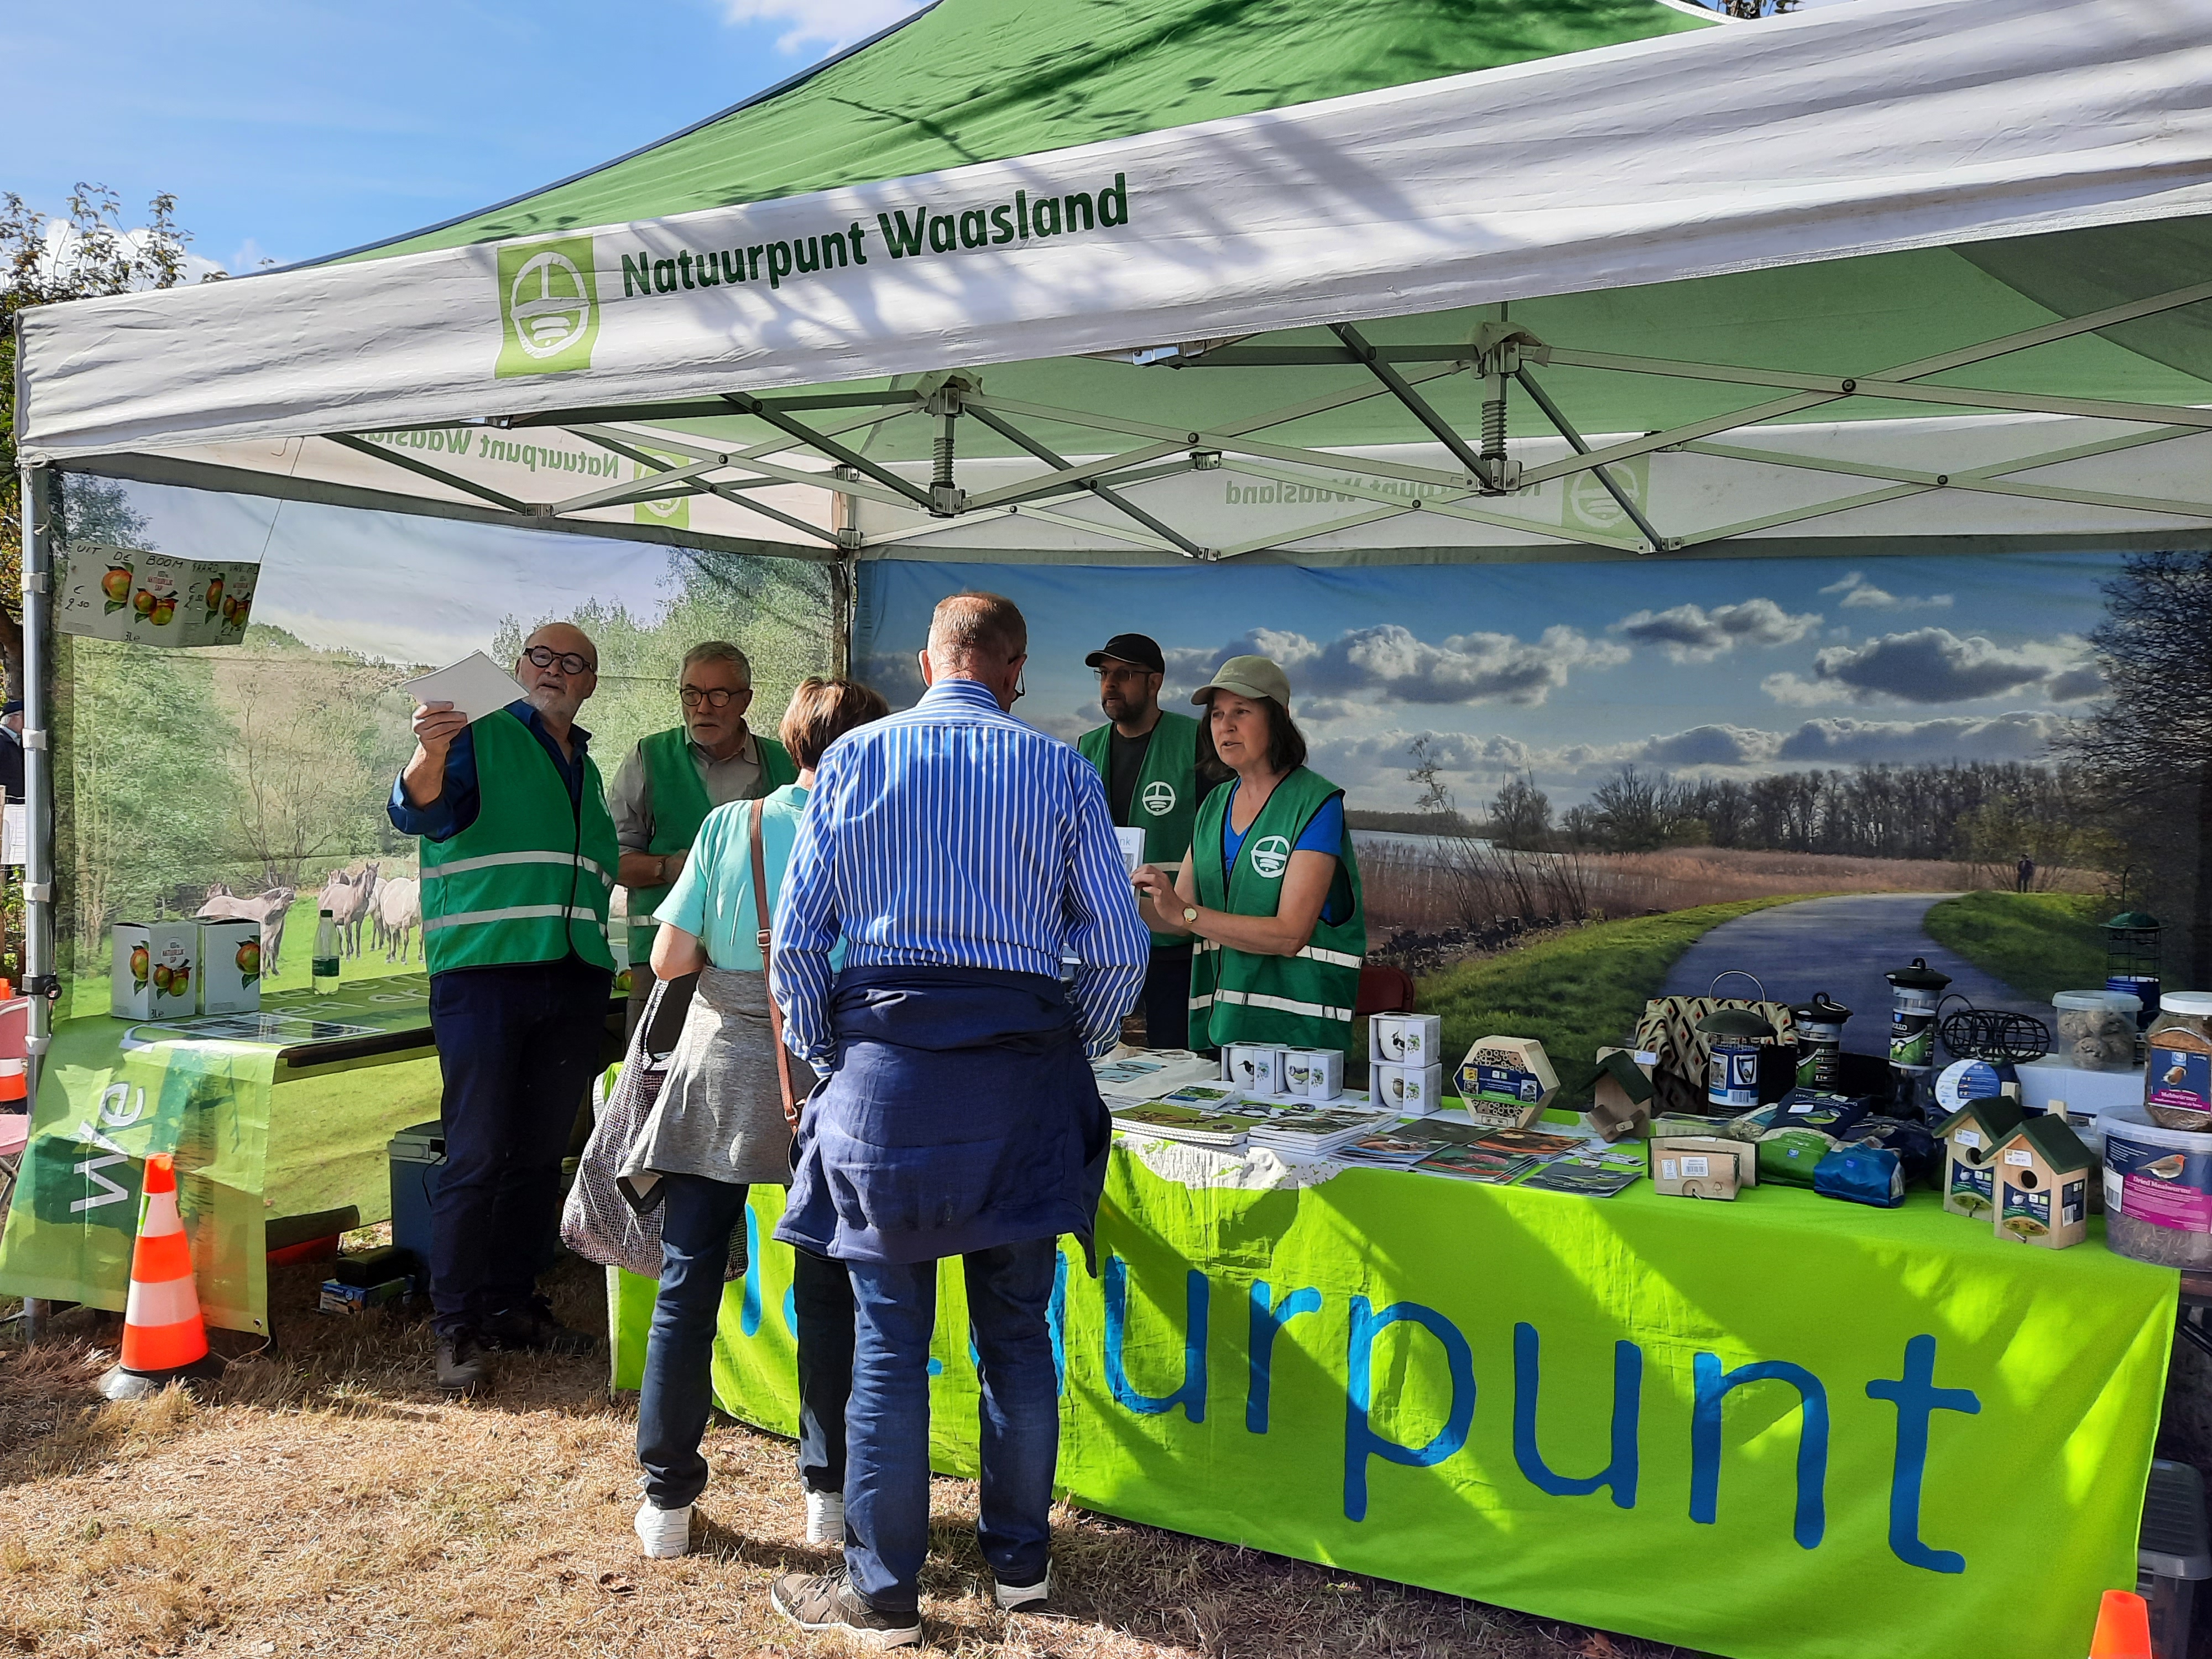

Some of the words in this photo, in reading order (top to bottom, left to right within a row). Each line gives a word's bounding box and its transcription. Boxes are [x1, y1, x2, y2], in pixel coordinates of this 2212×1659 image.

[620, 222, 868, 297] Natuurpunt
[876, 172, 1129, 260] Waasland
[77, 545, 102, 554] UIT
[113, 551, 132, 561] DE
[145, 555, 184, 568] BOOM
